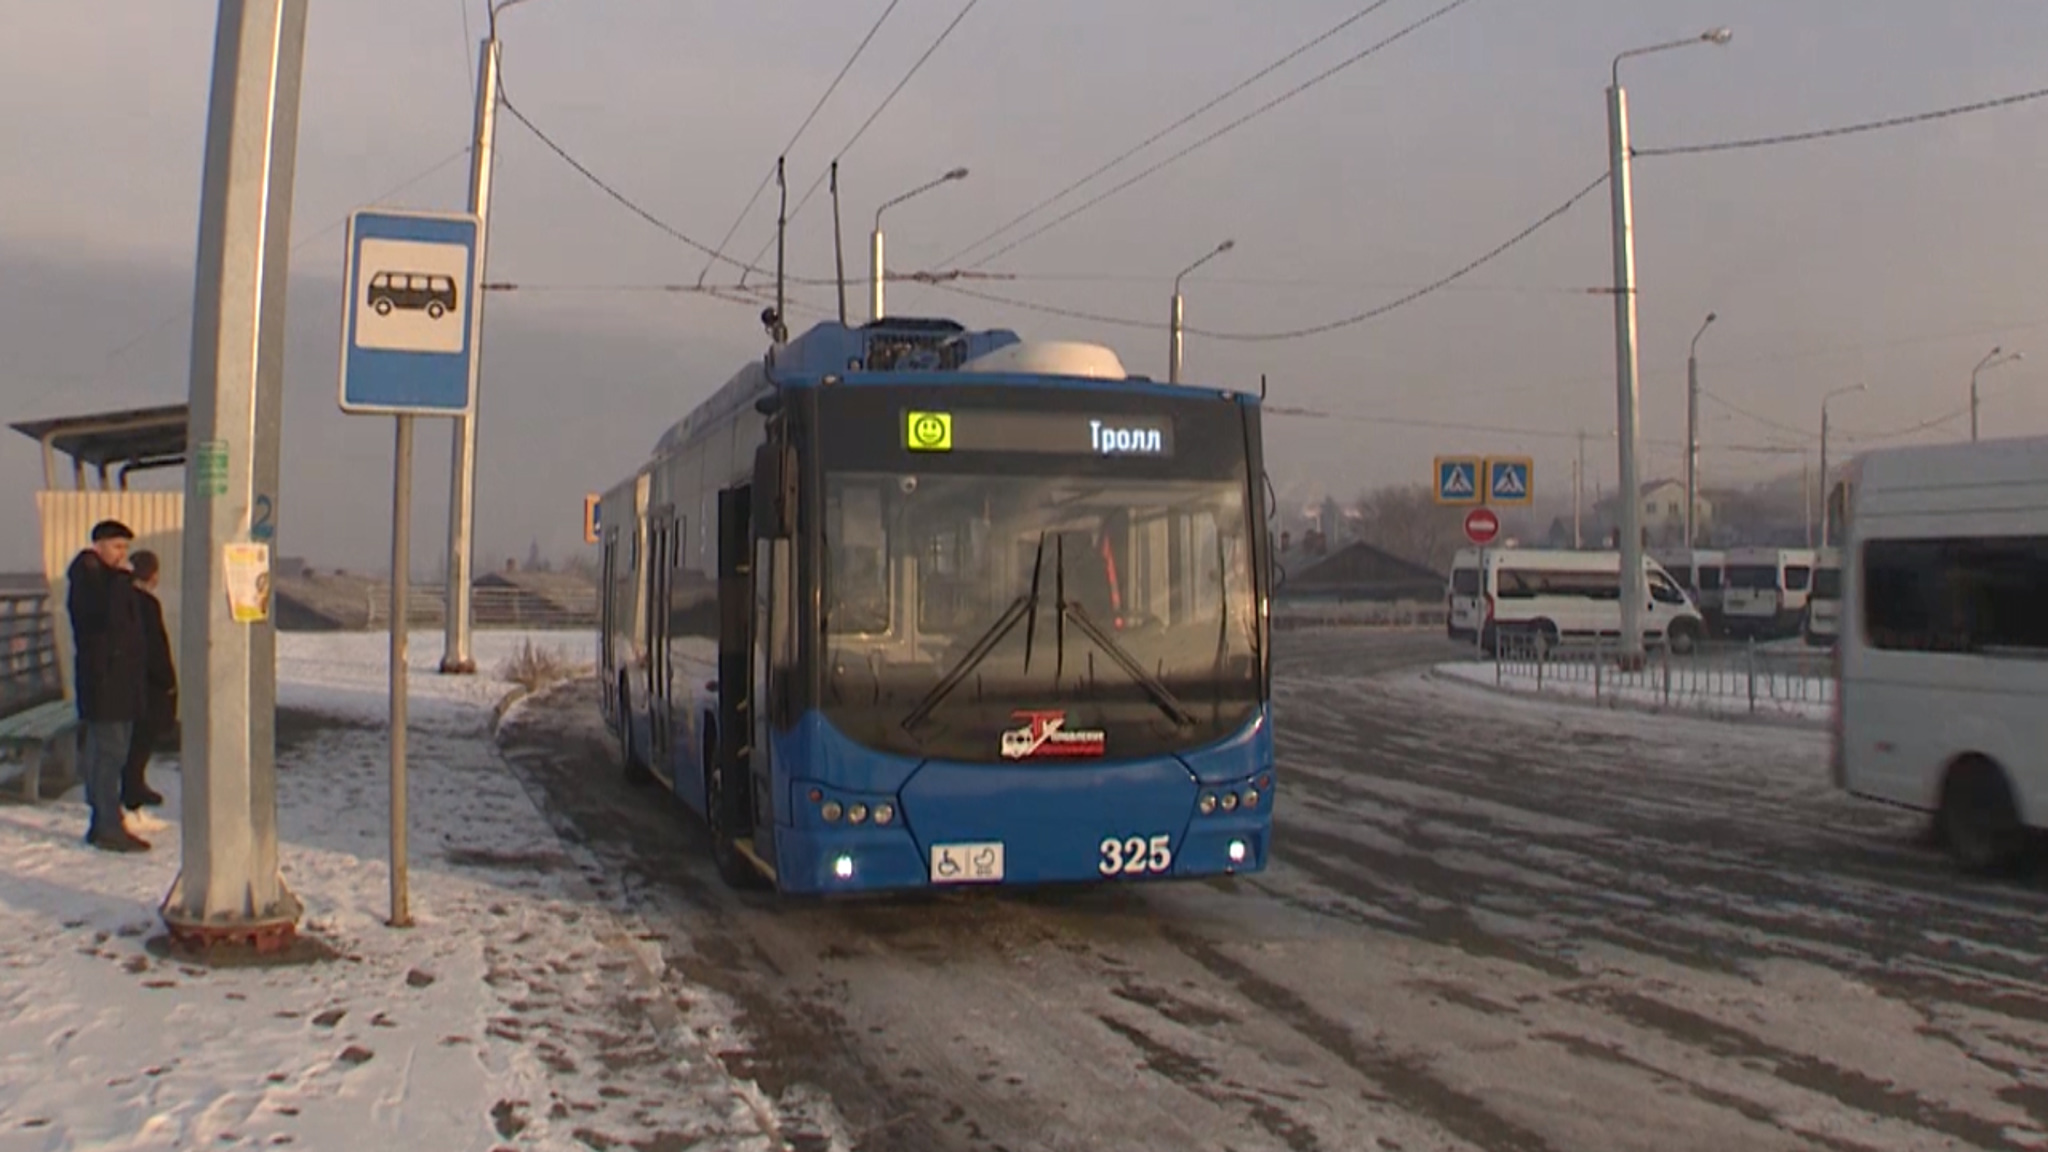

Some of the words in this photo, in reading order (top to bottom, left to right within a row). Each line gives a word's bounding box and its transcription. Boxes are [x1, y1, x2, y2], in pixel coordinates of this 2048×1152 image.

[1089, 420, 1161, 453] Тролл
[251, 494, 273, 538] 2
[1099, 834, 1171, 875] 325
